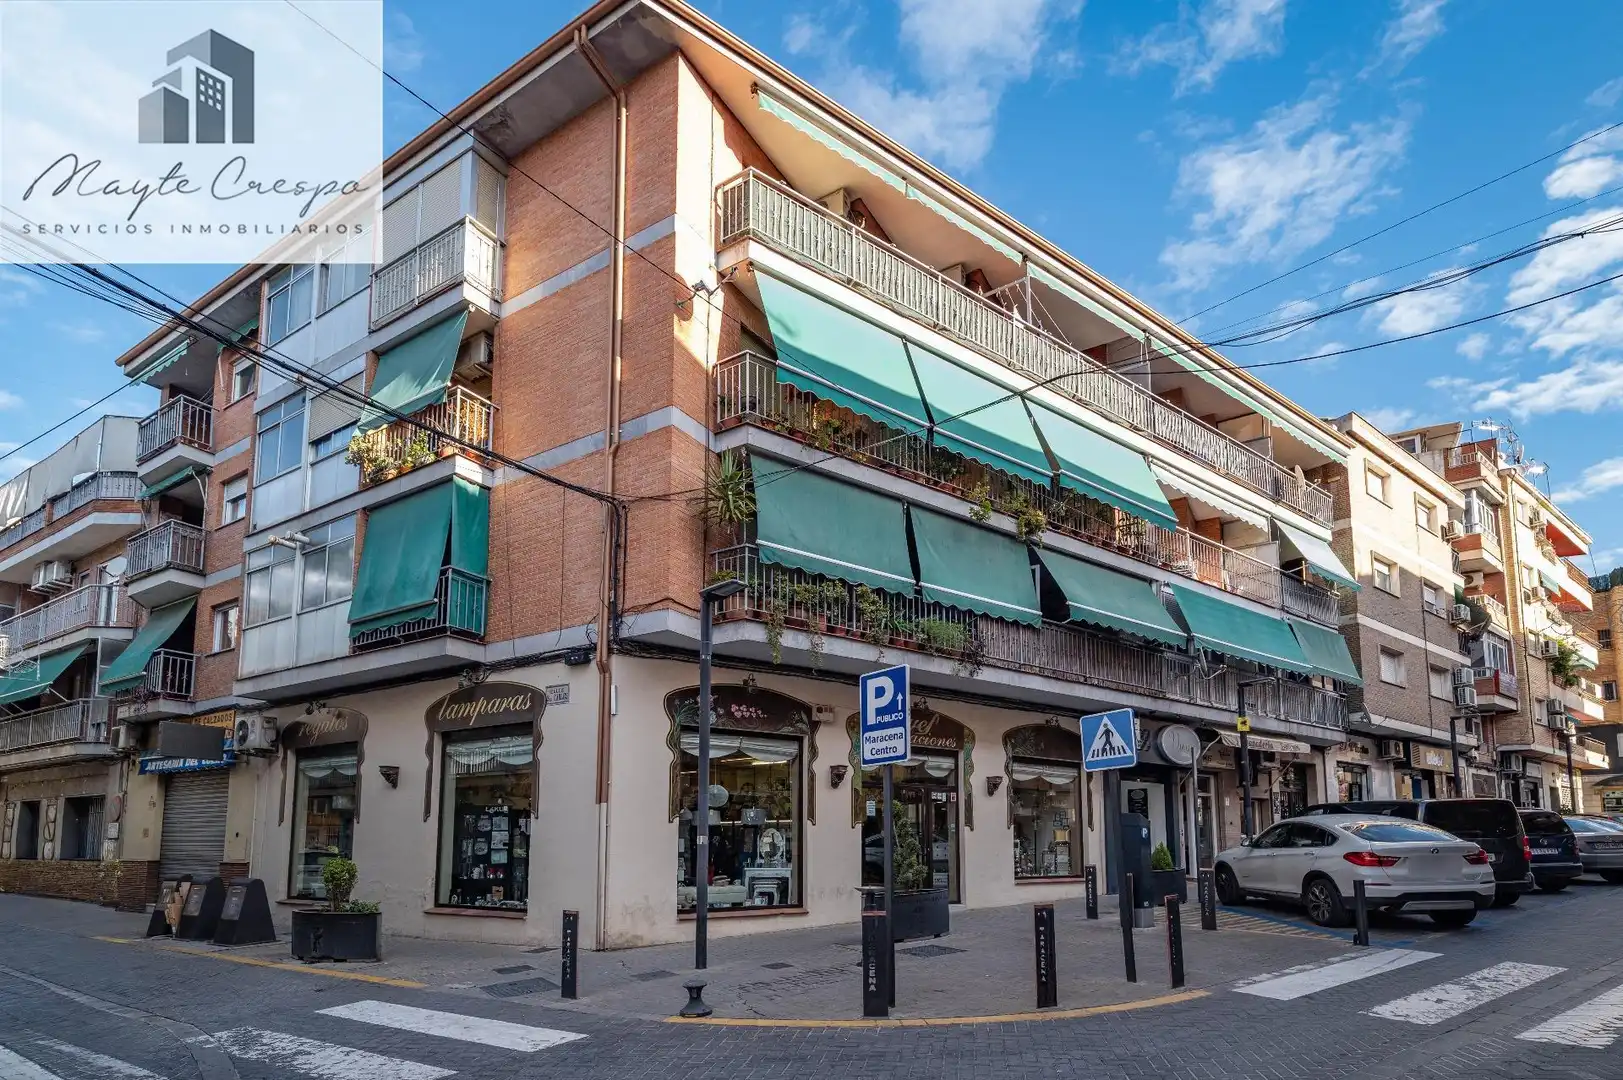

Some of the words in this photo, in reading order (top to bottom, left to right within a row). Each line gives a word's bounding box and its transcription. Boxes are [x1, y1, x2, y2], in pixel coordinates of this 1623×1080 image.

[876, 712, 904, 724] PUBLICO
[299, 716, 349, 745] regalos
[864, 731, 904, 745] Maracena
[910, 733, 957, 748] aciones
[870, 744, 898, 756] Centro
